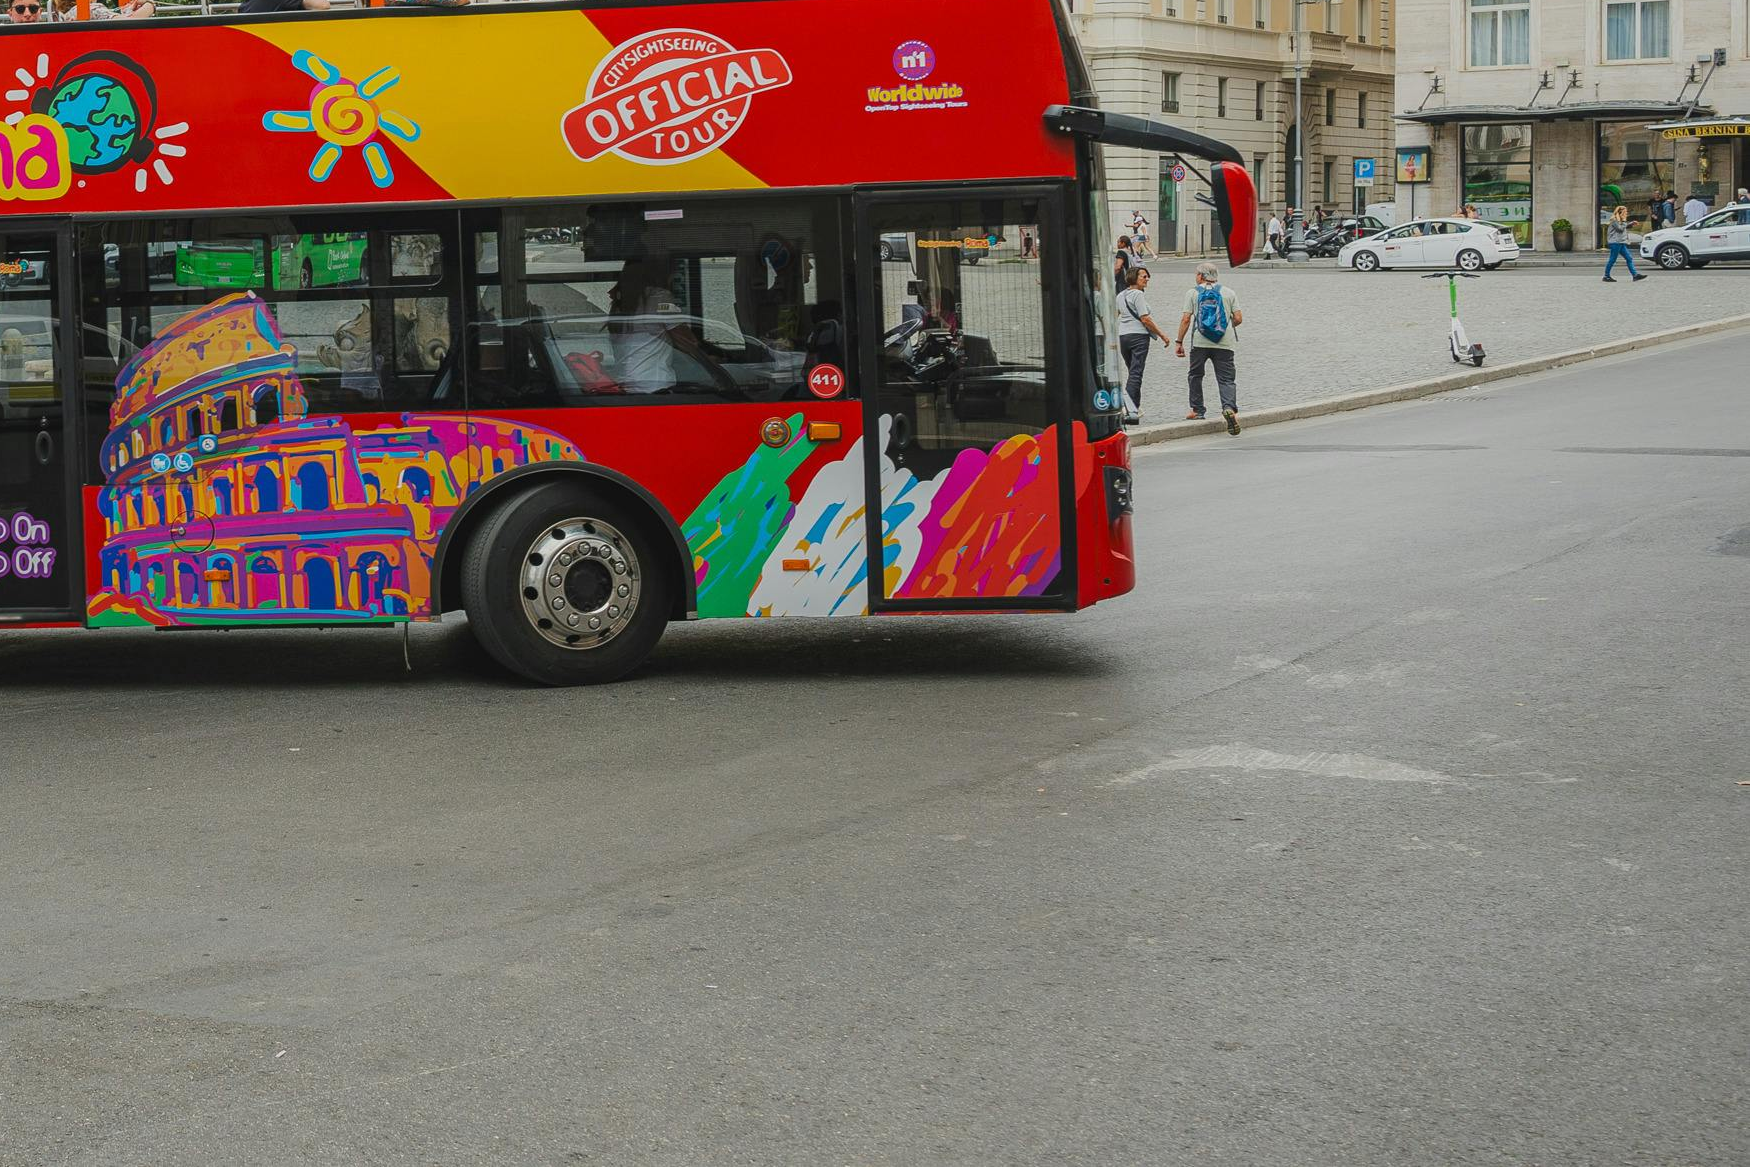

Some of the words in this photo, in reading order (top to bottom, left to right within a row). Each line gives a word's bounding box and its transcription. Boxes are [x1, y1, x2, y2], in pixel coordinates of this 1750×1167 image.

[603, 38, 717, 87] CITYSIGHTSEEING
[585, 56, 778, 144] OFFICIAL
[867, 83, 963, 102] Worldwide
[900, 102, 945, 110] Sightseeing
[651, 108, 737, 153] TOUR
[1667, 128, 1690, 139] SINA
[1695, 125, 1738, 136] BERNINI
[812, 373, 838, 387] 411
[13, 514, 48, 542] On
[14, 548, 54, 576] Off
